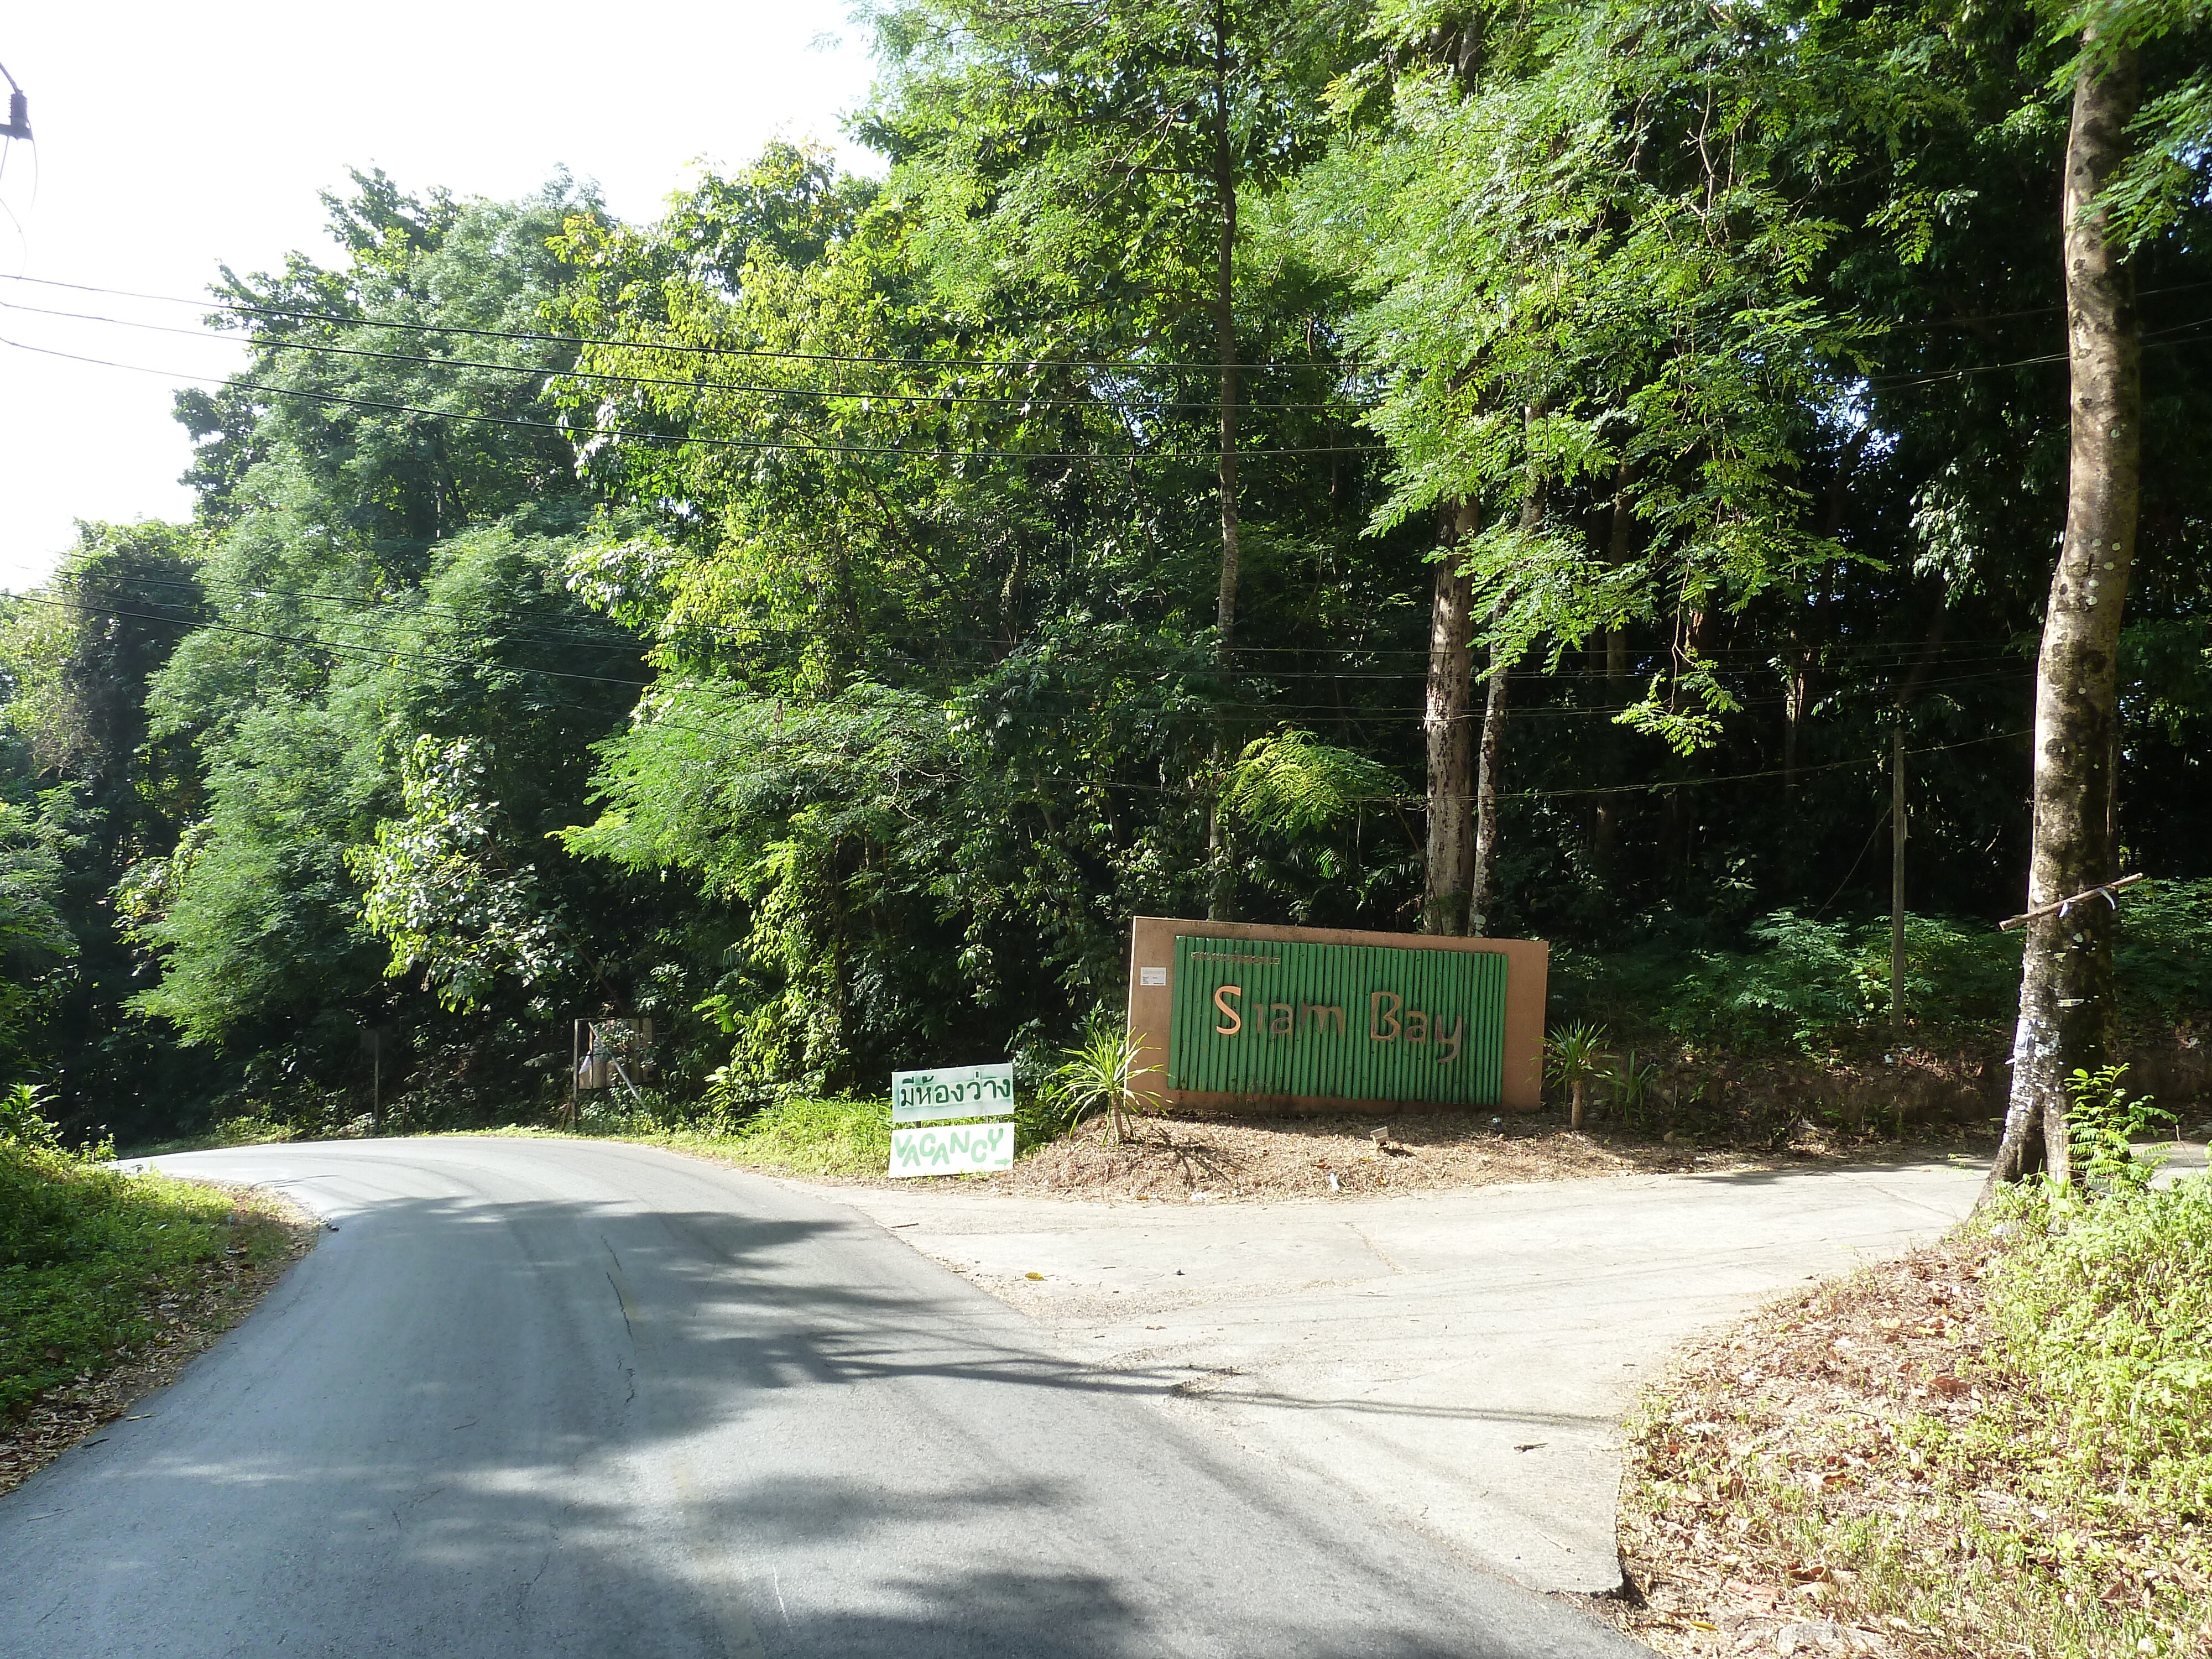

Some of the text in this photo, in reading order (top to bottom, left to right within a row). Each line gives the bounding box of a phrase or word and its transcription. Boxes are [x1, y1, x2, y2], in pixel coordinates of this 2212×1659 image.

[1214, 985, 1463, 1063] Siam Bay
[900, 1071, 1011, 1107] มีห้องว่าง
[894, 1128, 1004, 1168] VACANCY
